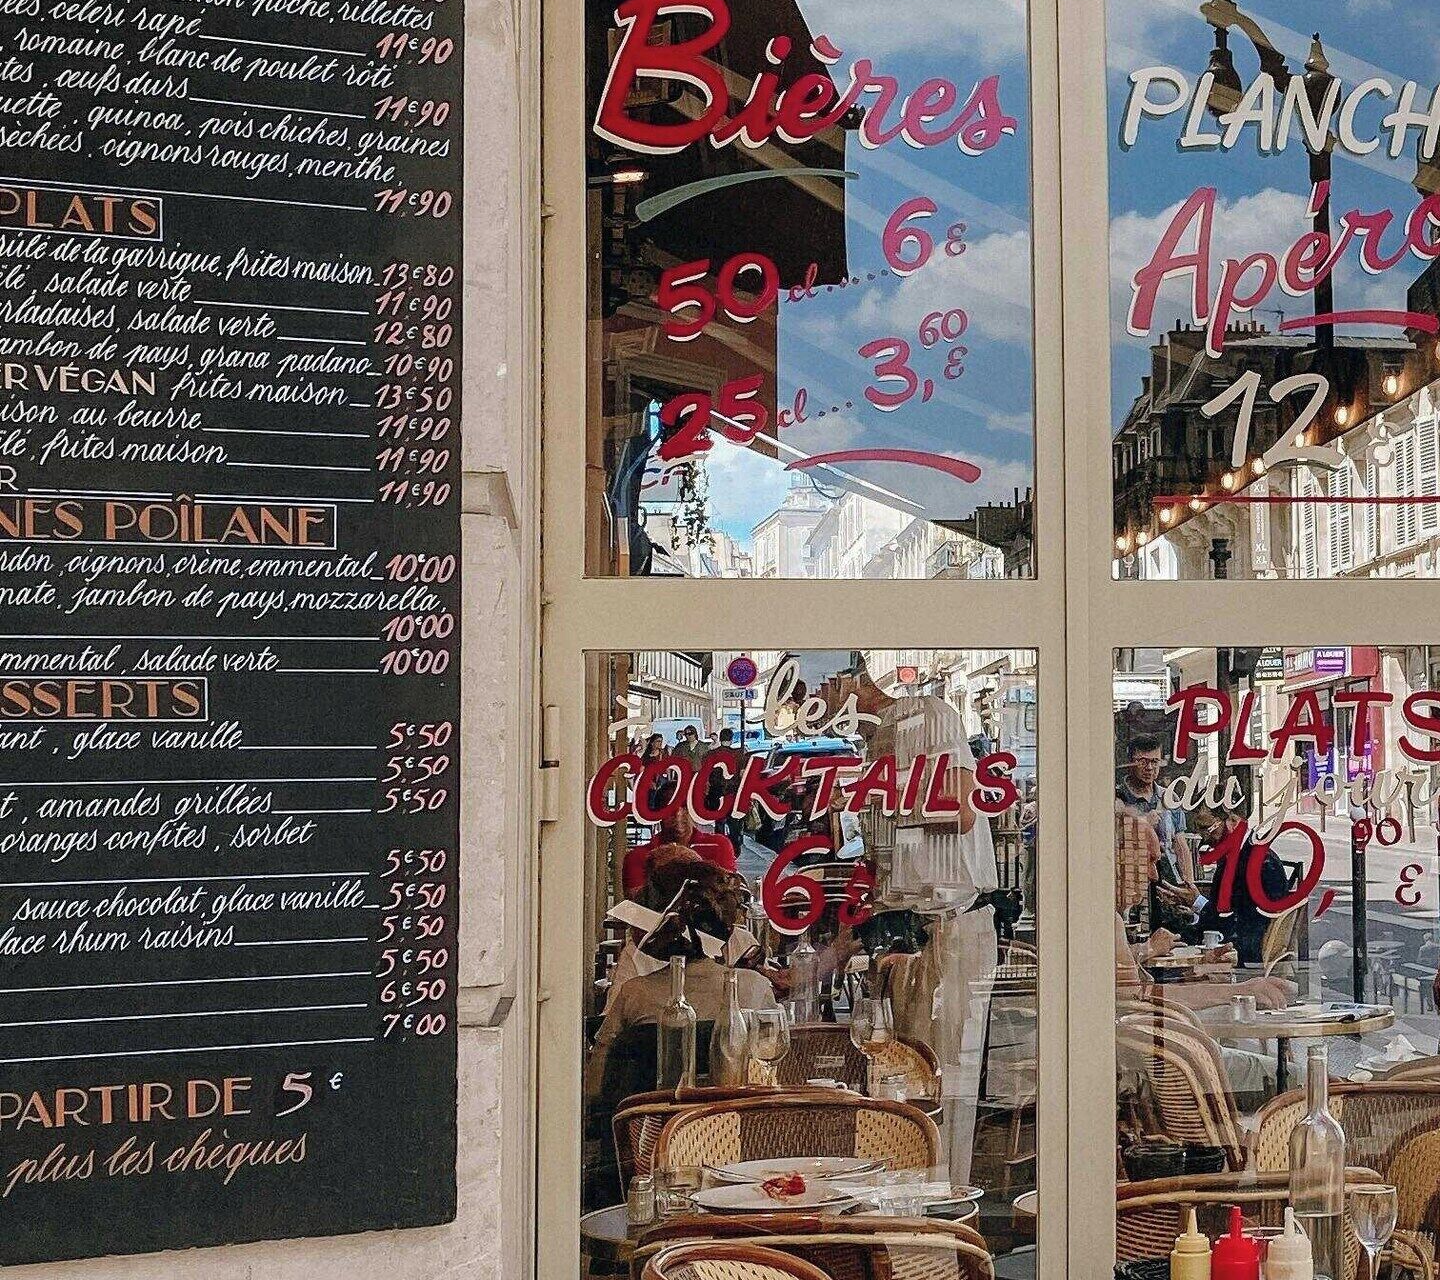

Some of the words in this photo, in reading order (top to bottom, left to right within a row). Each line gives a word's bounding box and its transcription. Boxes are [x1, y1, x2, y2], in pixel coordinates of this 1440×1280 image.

[137, 37, 209, 69] blanc
[211, 48, 242, 73] de
[243, 57, 338, 82] poulet
[343, 60, 398, 89] rôti
[123, 71, 189, 99] durs
[100, 130, 202, 167] oignons
[199, 111, 254, 139] pois
[354, 128, 450, 157] graines
[50, 238, 82, 261] de
[83, 238, 109, 263] la
[225, 247, 291, 281] frites
[292, 254, 372, 285] maison
[44, 266, 128, 297] salade
[137, 277, 193, 302] verte
[127, 308, 210, 334] salade
[219, 312, 277, 338] verte
[86, 336, 117, 361] de
[196, 346, 270, 376] grana
[273, 347, 372, 378] padano
[34, 361, 156, 396] VÉGAN
[171, 370, 242, 402] frites
[246, 376, 348, 406] maison
[69, 406, 107, 426] au
[113, 399, 202, 429] beurre
[40, 428, 116, 465] frites
[122, 434, 228, 463] maison
[106, 494, 325, 545] POÎLANE
[246, 551, 378, 578] emmental
[64, 580, 176, 615] jambon
[182, 584, 213, 608] de
[133, 645, 214, 671] salade
[222, 646, 279, 672] verte
[746, 658, 883, 737] les
[67, 723, 141, 759] glace
[152, 720, 242, 749] vanille
[586, 751, 1020, 827] COCKTAILS
[1162, 754, 1245, 812] du
[39, 788, 161, 819] amandes
[168, 784, 273, 822] grillées
[230, 815, 318, 848] sorbet
[13, 897, 90, 920] sauce
[203, 883, 275, 926] glace
[280, 880, 366, 911] vanille
[52, 920, 130, 954] rhum
[138, 920, 235, 951] raisins
[187, 1077, 253, 1118] DE
[2, 1143, 95, 1198] plus
[104, 1136, 155, 1176] les
[162, 1128, 308, 1185] chèques
